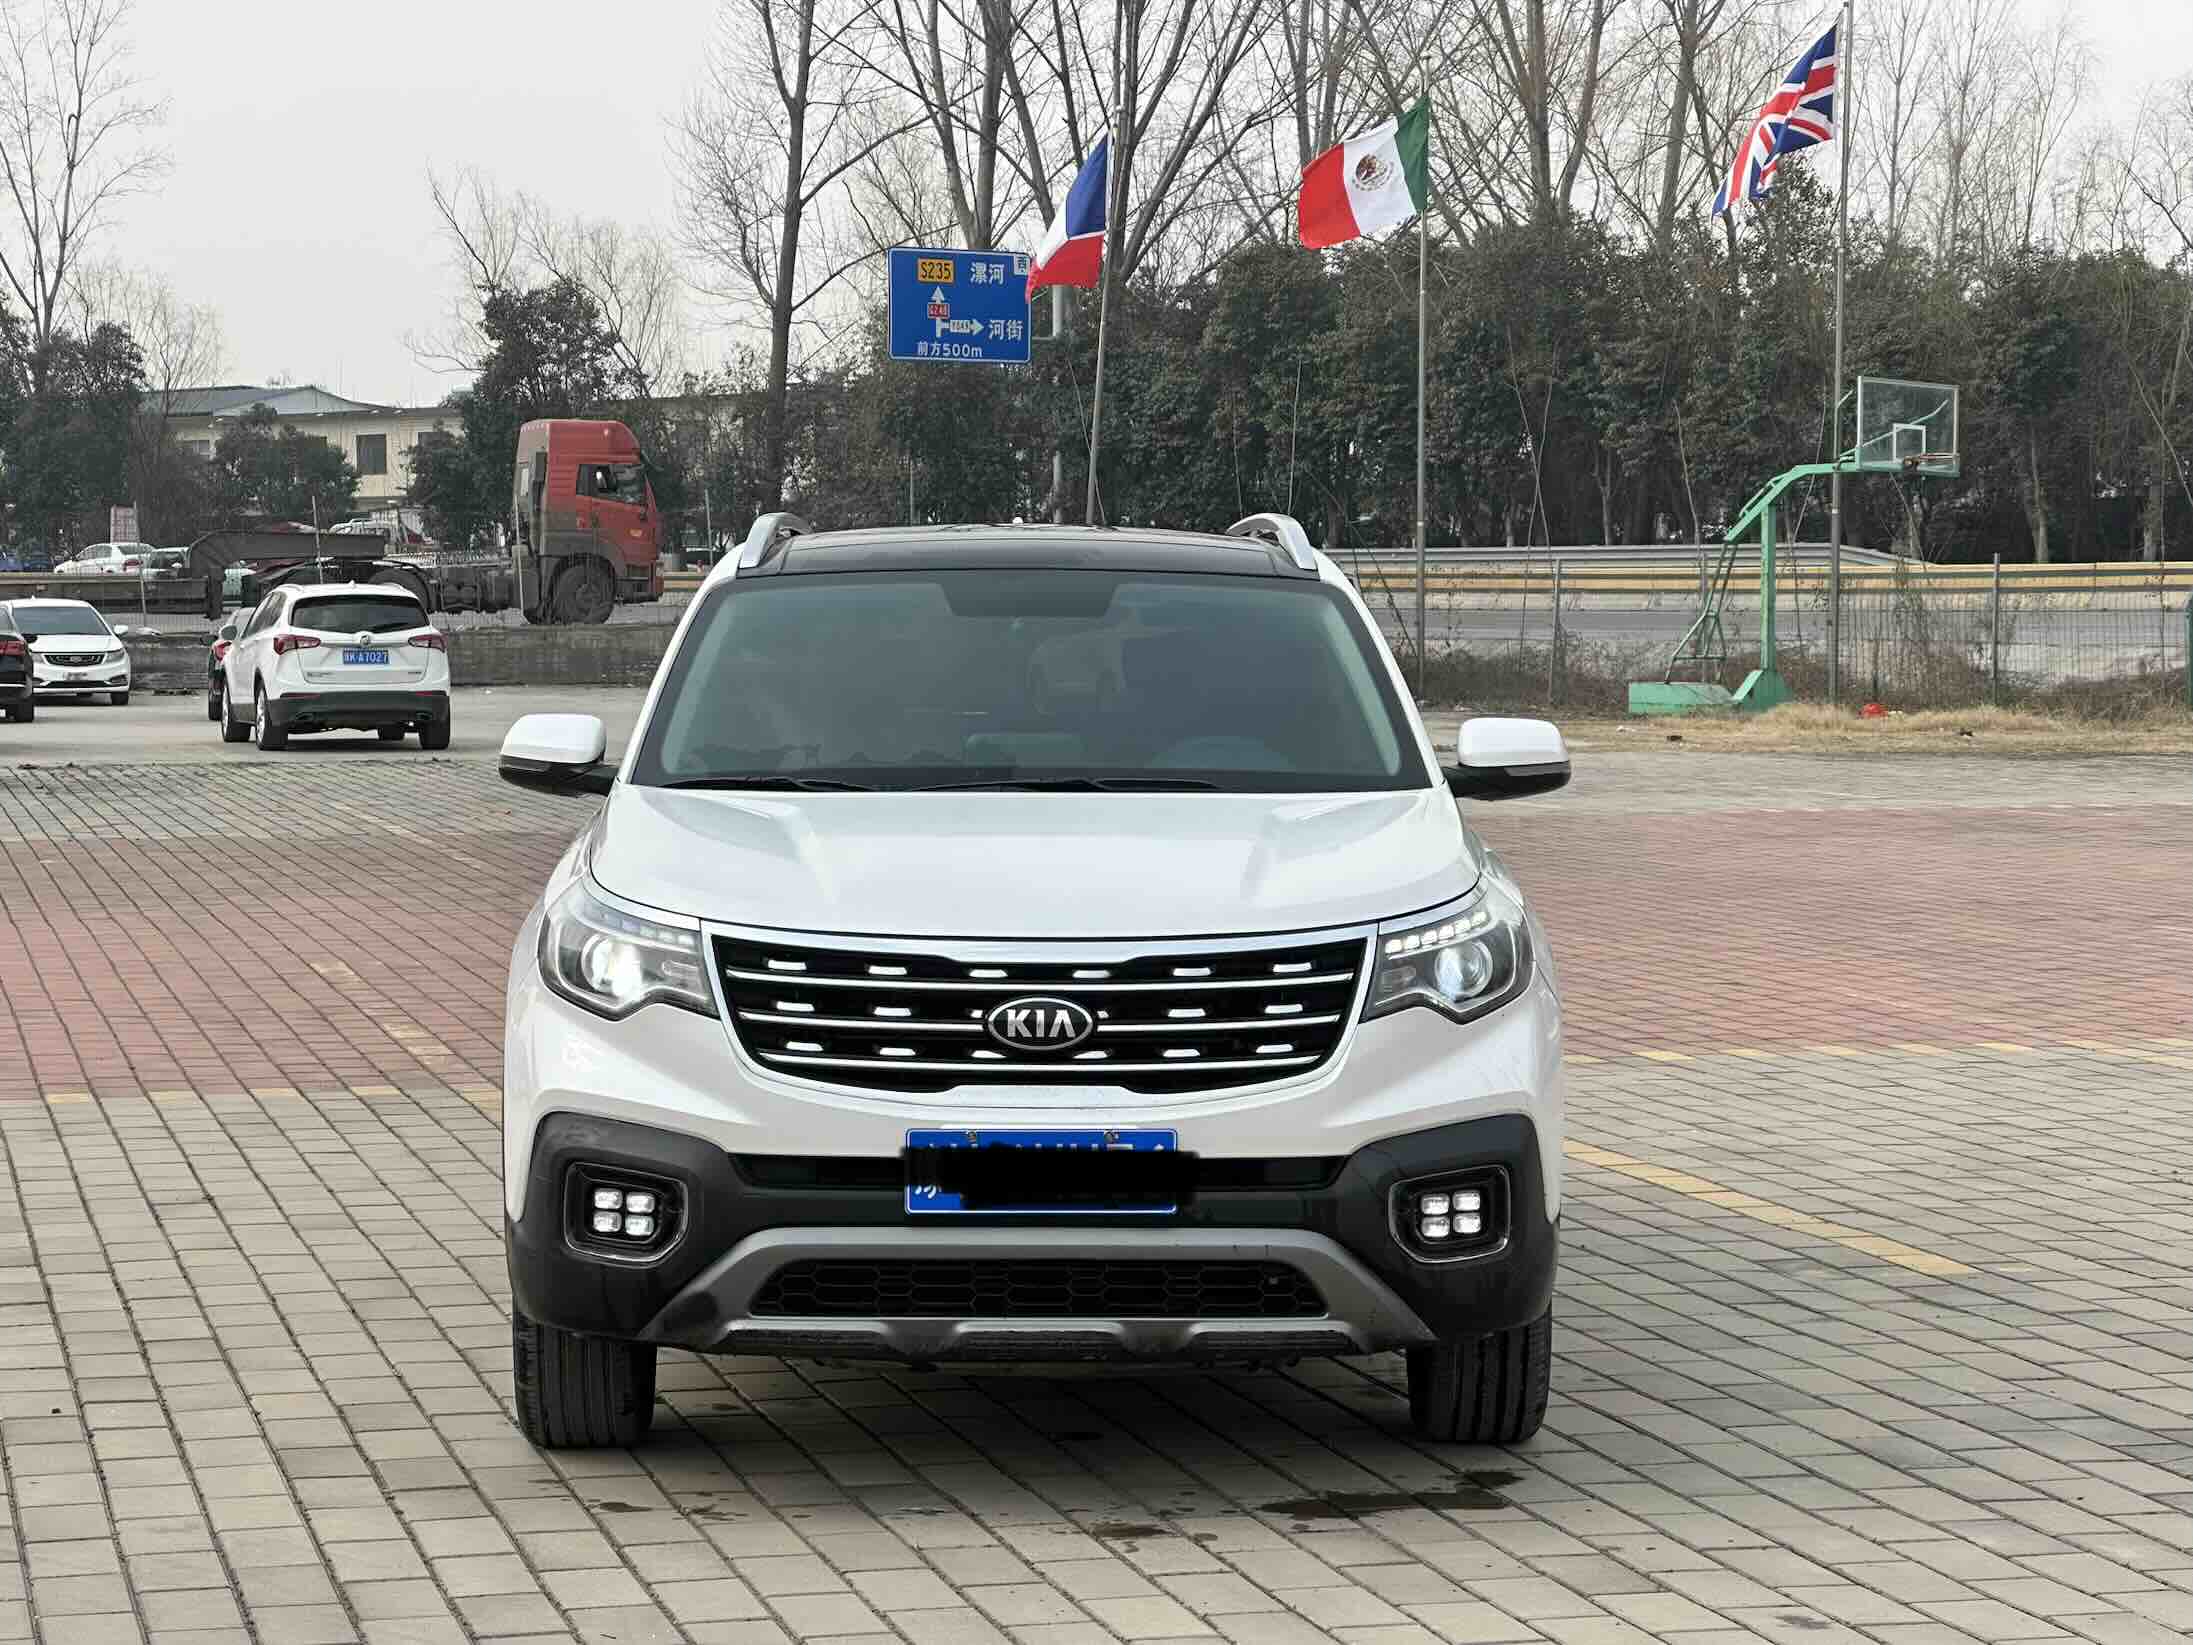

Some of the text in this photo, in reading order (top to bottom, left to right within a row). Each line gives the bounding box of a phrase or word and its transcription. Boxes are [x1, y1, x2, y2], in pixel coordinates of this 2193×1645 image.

[920, 261, 952, 280] S235
[970, 261, 1005, 285] 漯河
[988, 319, 1024, 341] 河街
[917, 340, 983, 357] 前方500m
[1006, 1009, 1076, 1038] KIA
